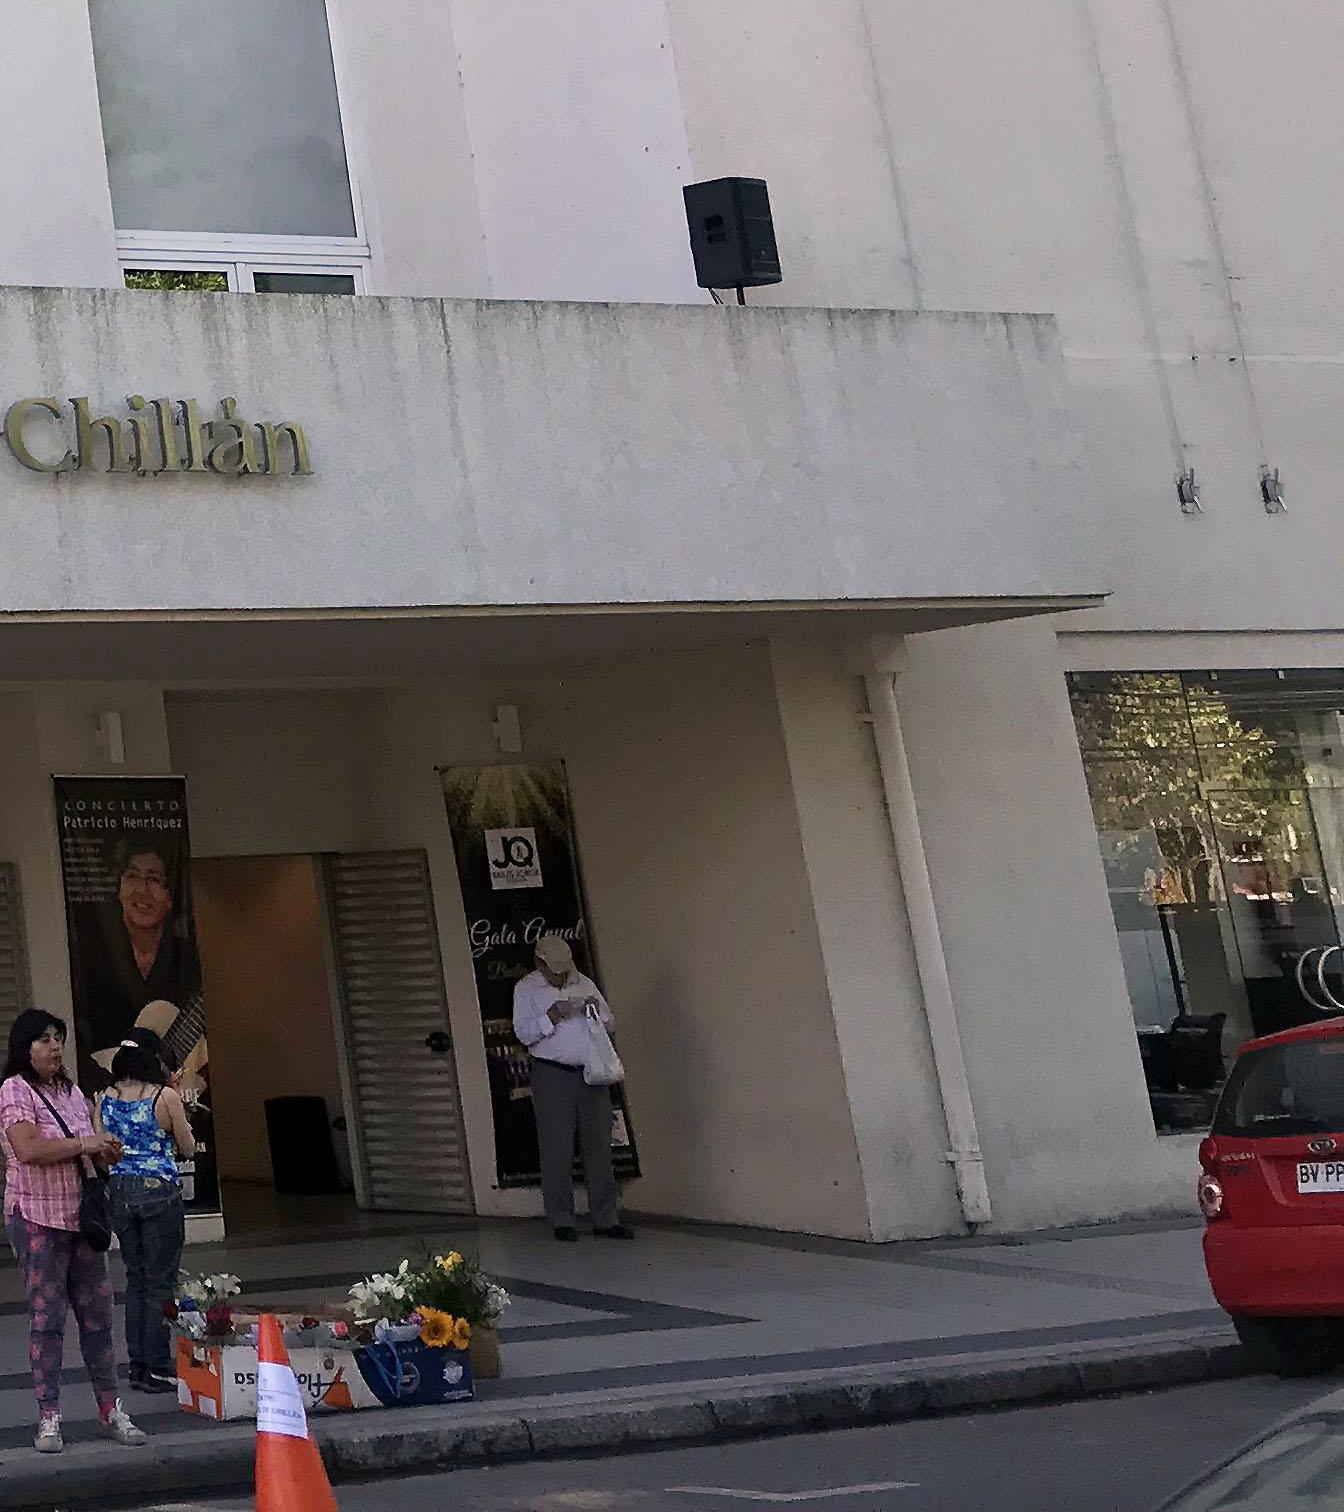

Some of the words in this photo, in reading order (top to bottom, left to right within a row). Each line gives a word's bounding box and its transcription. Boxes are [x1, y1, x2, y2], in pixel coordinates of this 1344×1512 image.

[5, 394, 313, 480] Chillán
[64, 799, 180, 812] CONCIERTO
[1299, 1164, 1318, 1184] BV
